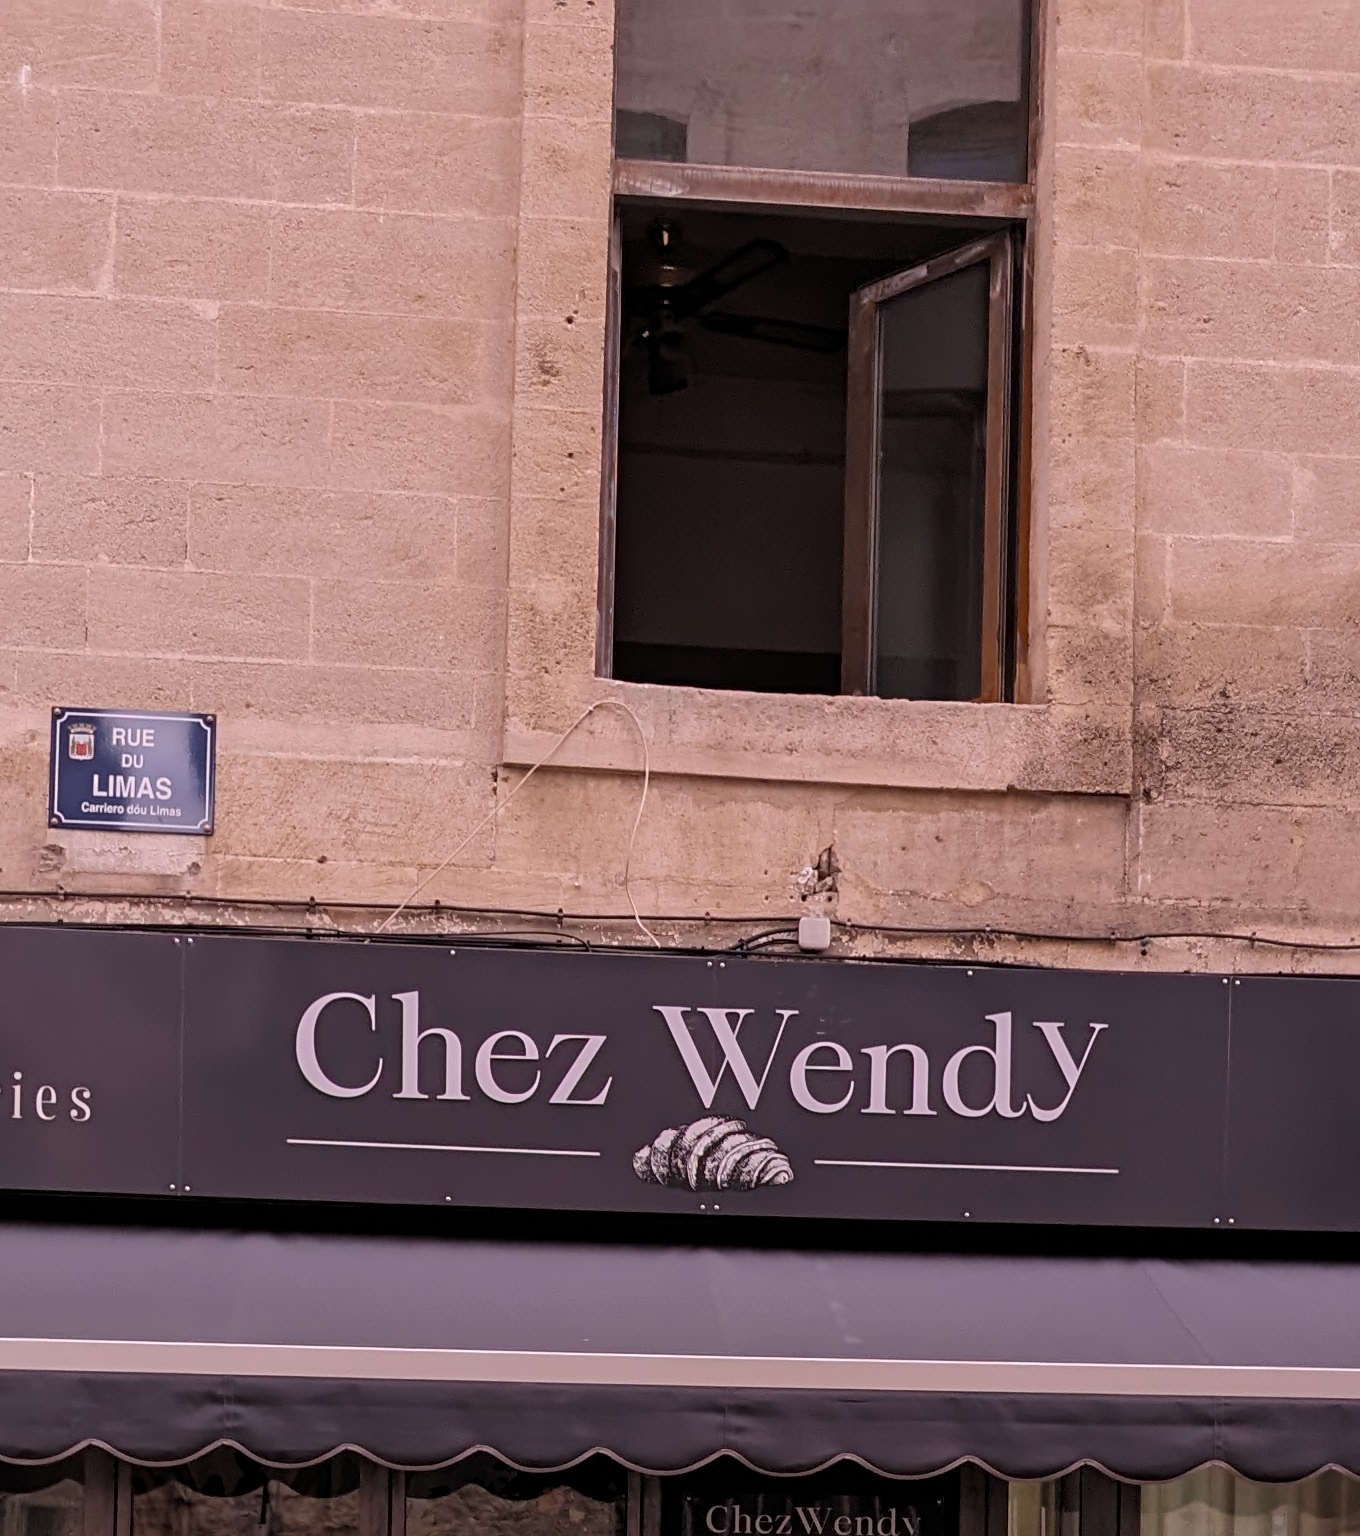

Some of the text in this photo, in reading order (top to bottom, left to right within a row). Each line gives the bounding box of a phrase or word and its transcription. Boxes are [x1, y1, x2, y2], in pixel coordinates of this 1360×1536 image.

[112, 728, 155, 747] RUE
[121, 754, 144, 768] DU
[93, 774, 172, 800] LIMAS
[81, 802, 124, 814] Carriero
[150, 805, 181, 817] Limas
[294, 989, 1109, 1122] Chez Wendy
[706, 1504, 792, 1535] Chez
